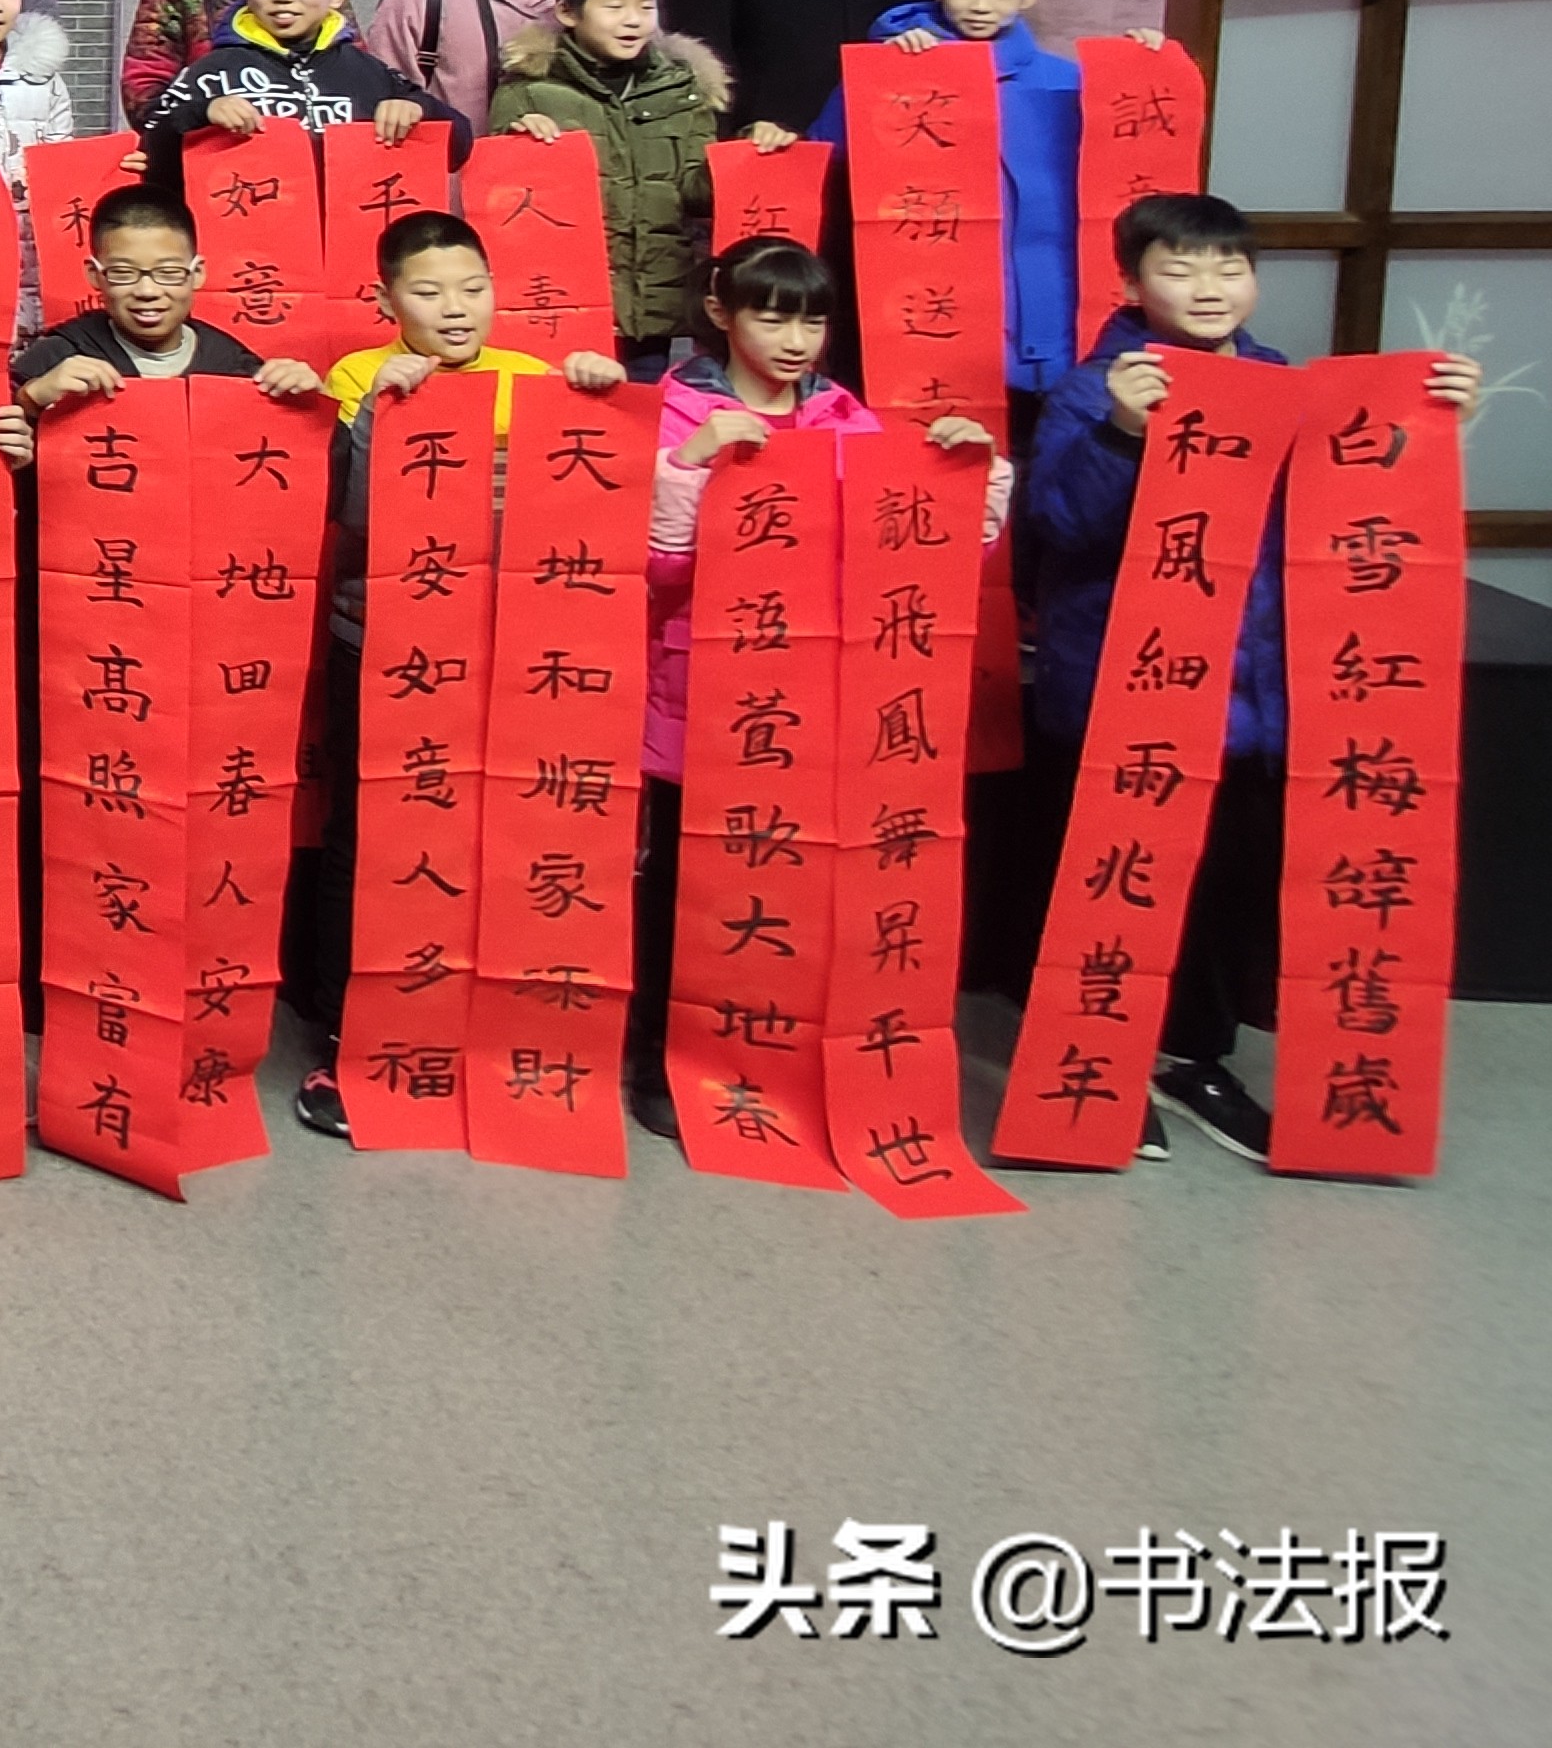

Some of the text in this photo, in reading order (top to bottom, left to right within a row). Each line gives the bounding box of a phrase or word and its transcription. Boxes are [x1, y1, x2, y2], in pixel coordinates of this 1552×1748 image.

[210, 170, 294, 326] 如意
[501, 187, 579, 339] 人壽
[366, 430, 470, 1101] 平安如意人多福
